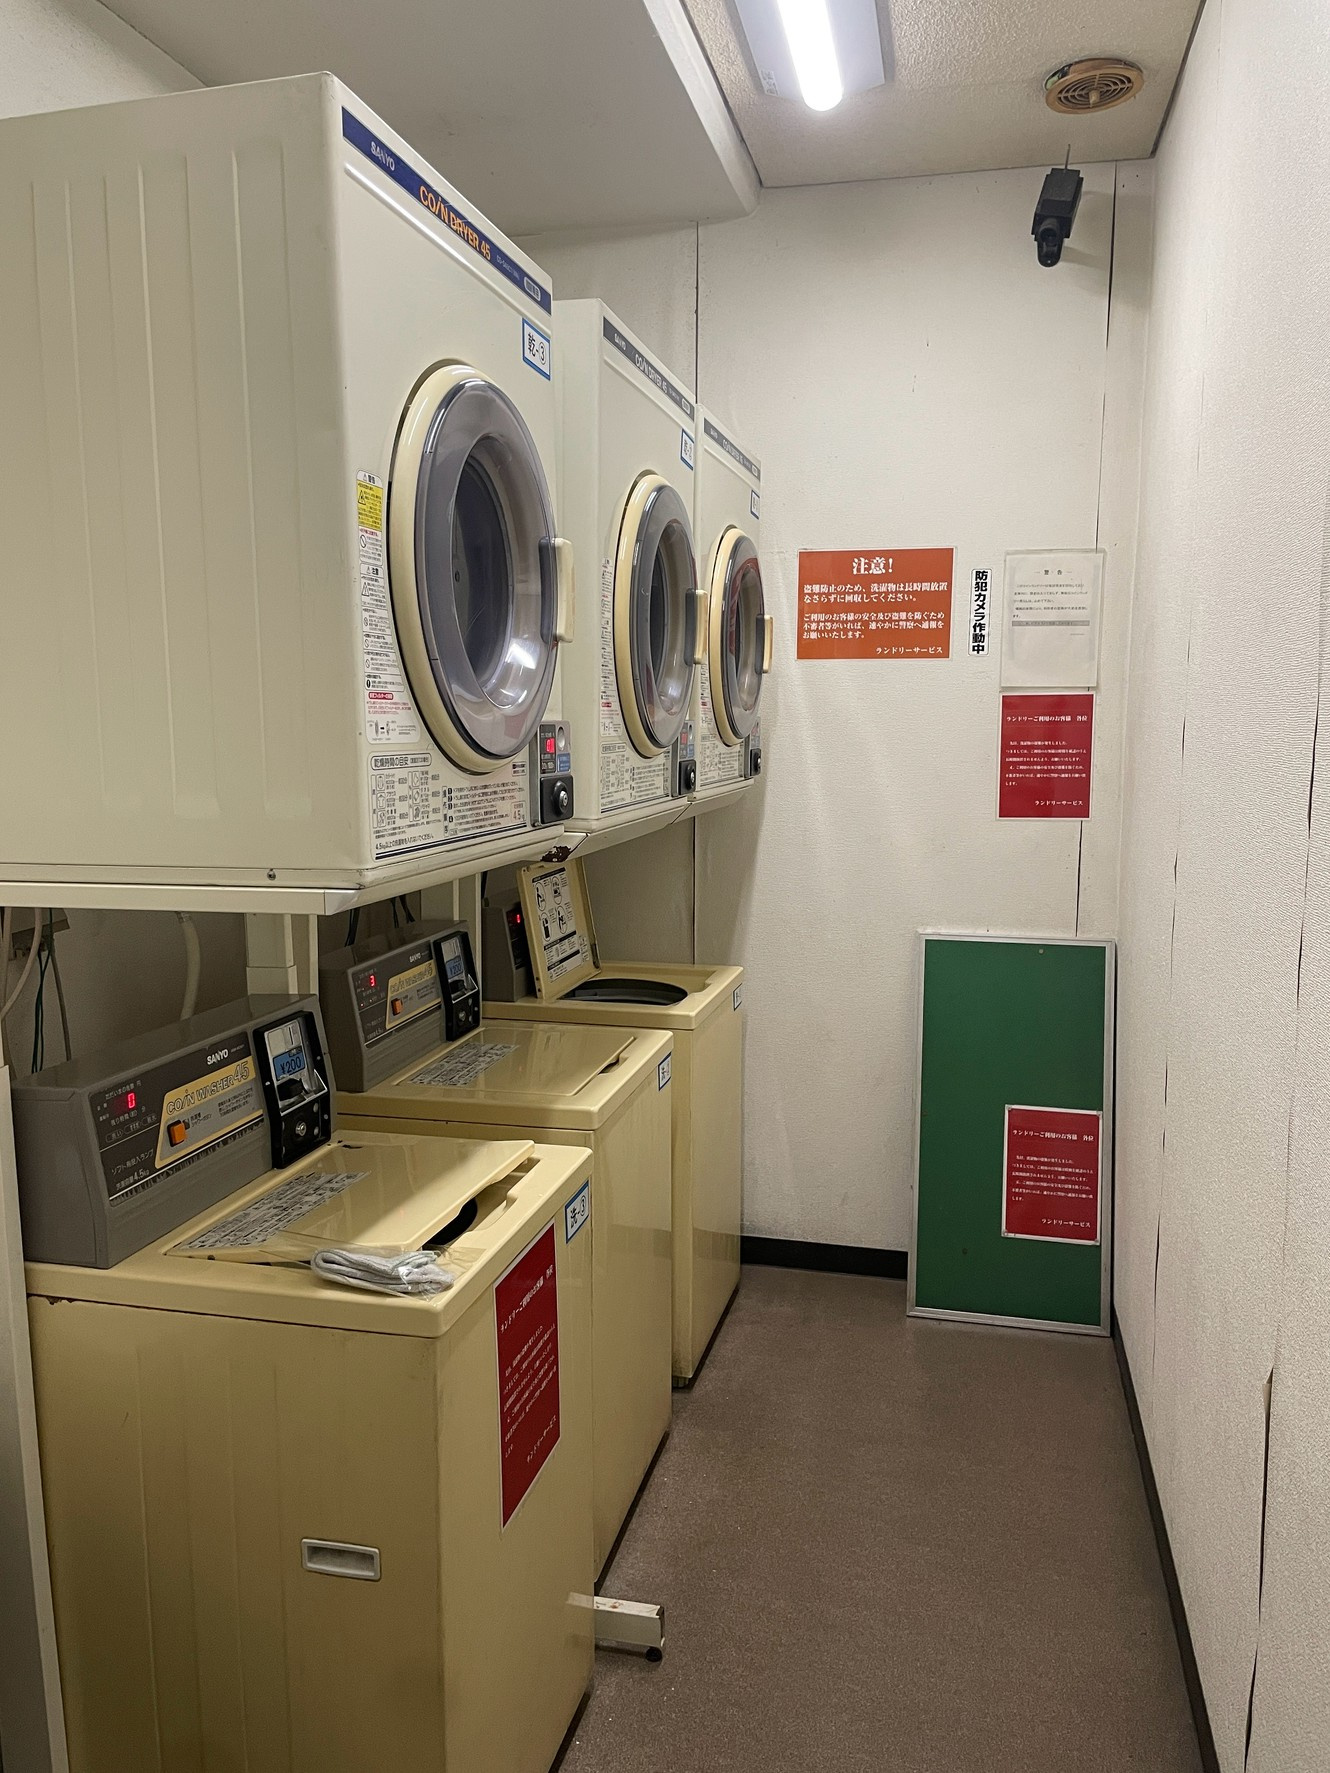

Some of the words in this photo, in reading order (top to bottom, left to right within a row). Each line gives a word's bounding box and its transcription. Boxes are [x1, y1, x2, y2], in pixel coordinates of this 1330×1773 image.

[371, 141, 395, 171] SANYO
[420, 185, 448, 224] COIN
[449, 212, 480, 251] DRYER
[480, 239, 491, 261] 45
[803, 582, 948, 594] 盗難防止のため、洗濯物は長時間放置
[803, 593, 917, 604] なさらずに回収してください。
[803, 611, 945, 622] ご利用のお客様の安全及び盗難を防ぐため
[972, 570, 988, 655] 防犯カメラ作動中
[802, 631, 865, 640] お願いいたします。
[876, 646, 943, 655] ランドリーサービス
[206, 1049, 229, 1066] SANYO
[166, 1088, 196, 1116] COIN
[197, 1075, 234, 1103] WASHER
[233, 1061, 250, 1083] 45
[127, 1092, 136, 1109] 0
